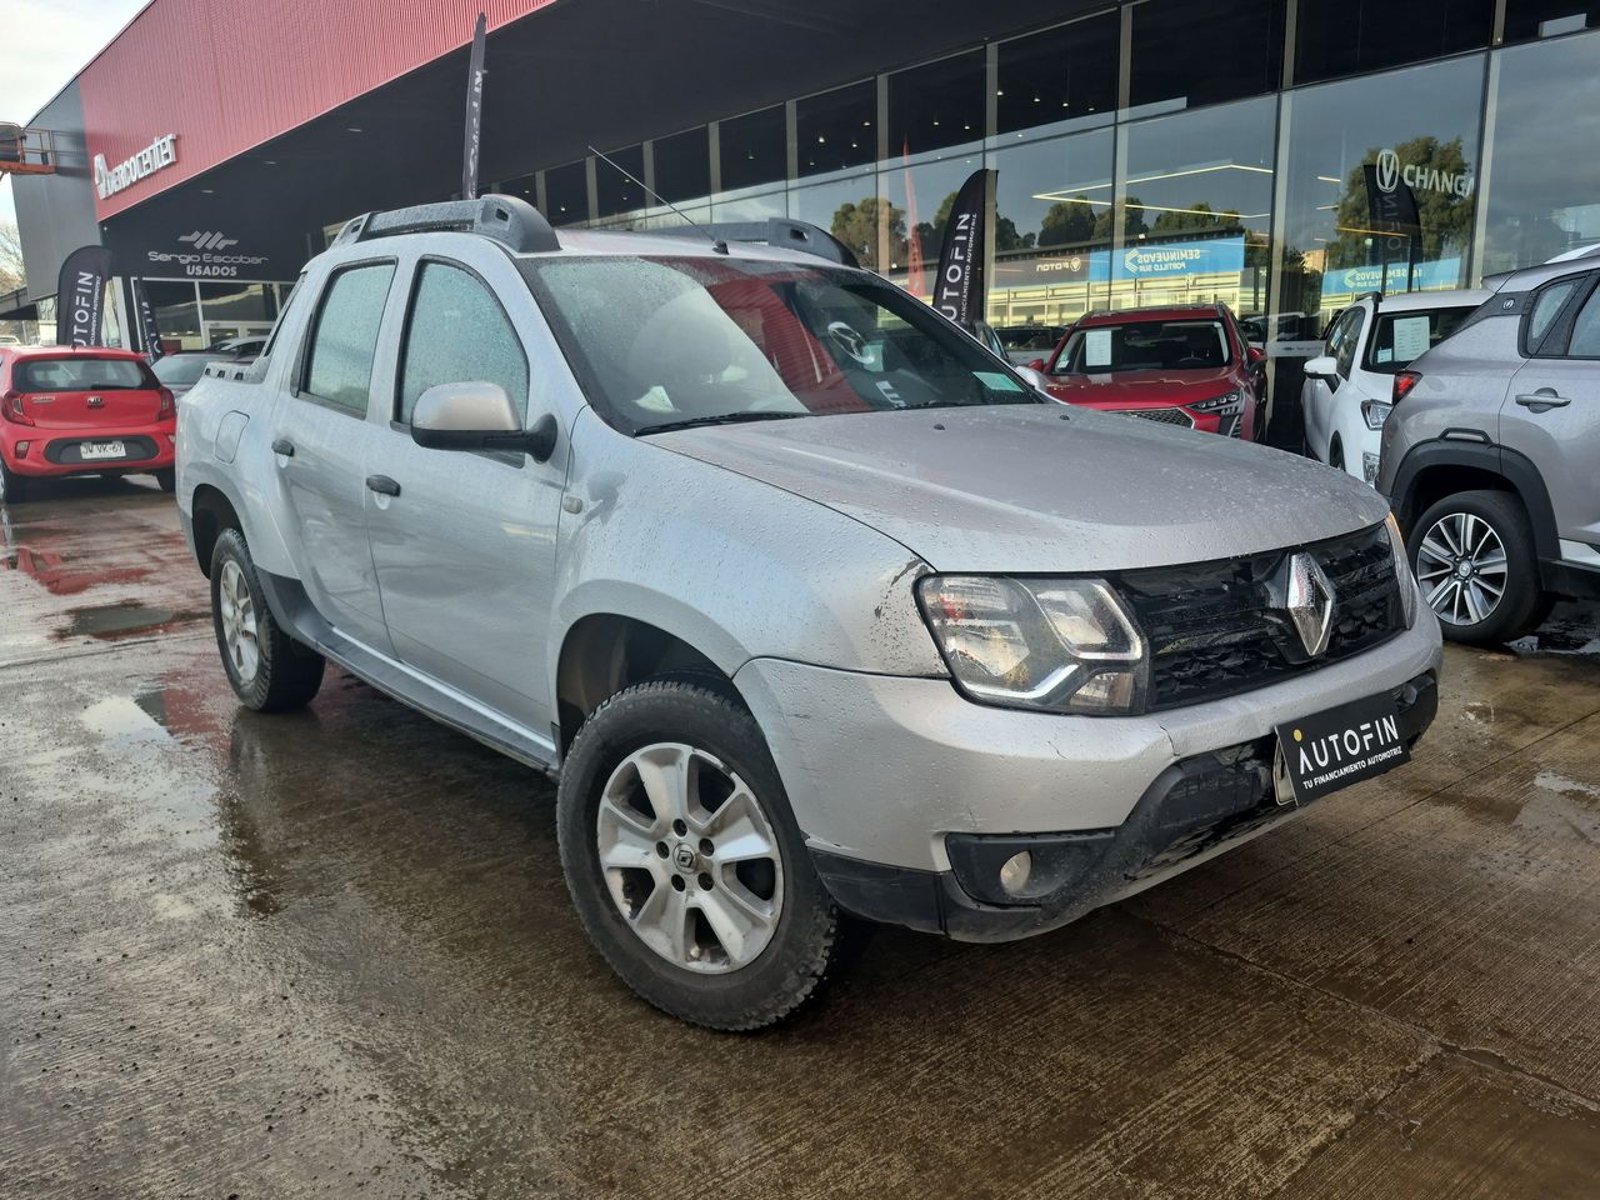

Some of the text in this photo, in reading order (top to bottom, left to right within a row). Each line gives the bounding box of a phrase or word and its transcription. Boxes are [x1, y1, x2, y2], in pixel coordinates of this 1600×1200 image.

[1403, 164, 1475, 198] CHANGA
[186, 265, 237, 276] USADOS
[202, 253, 269, 265] Escobar
[941, 213, 970, 321] UTOFIN
[74, 271, 94, 347] UTOFIN
[960, 264, 971, 323] NANCIAMIENTO
[1294, 714, 1400, 775] AUTOFIN
[1302, 745, 1402, 790] TU FINANCIAMIENTO AUTOMOTRIZ
